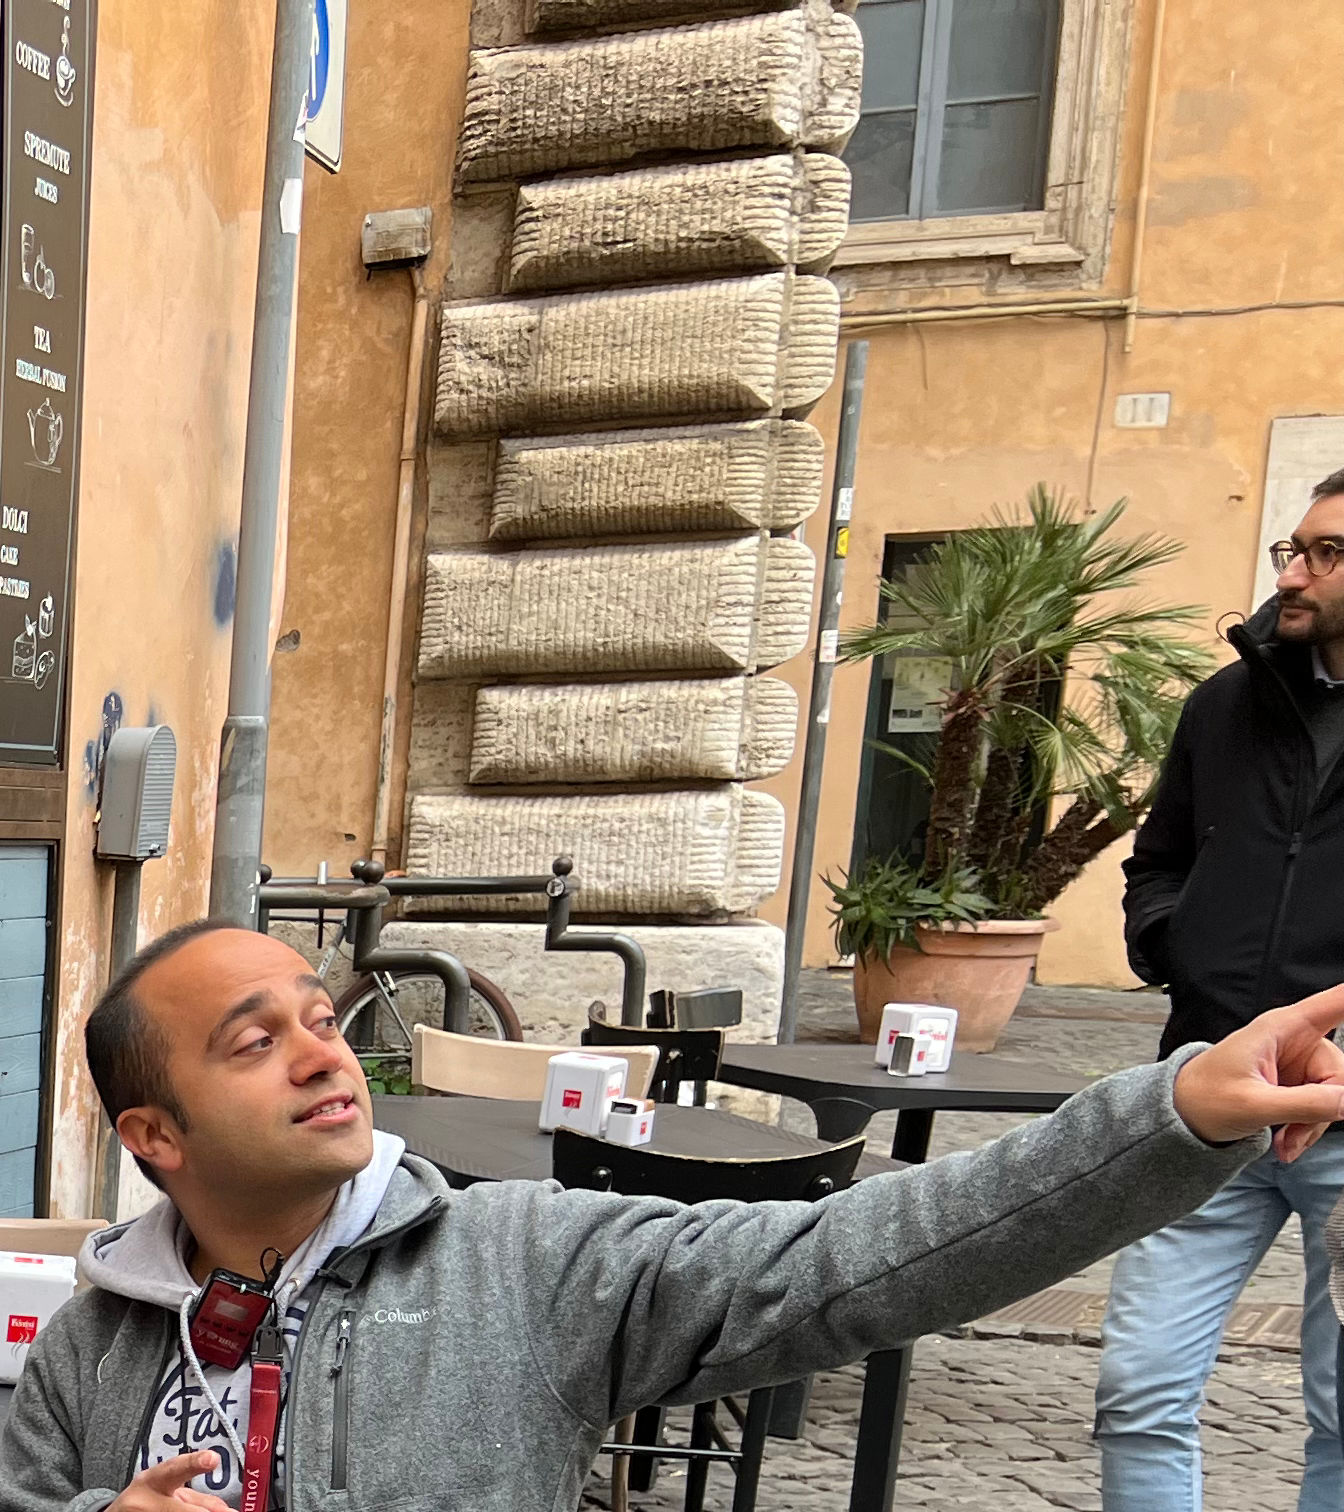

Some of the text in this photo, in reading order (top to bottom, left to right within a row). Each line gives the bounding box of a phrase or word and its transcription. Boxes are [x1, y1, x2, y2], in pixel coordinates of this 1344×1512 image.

[15, 41, 50, 80] COFFEE
[24, 130, 70, 175] SPREMUTE
[33, 325, 51, 354] TEA
[2, 505, 29, 534] DOLCI
